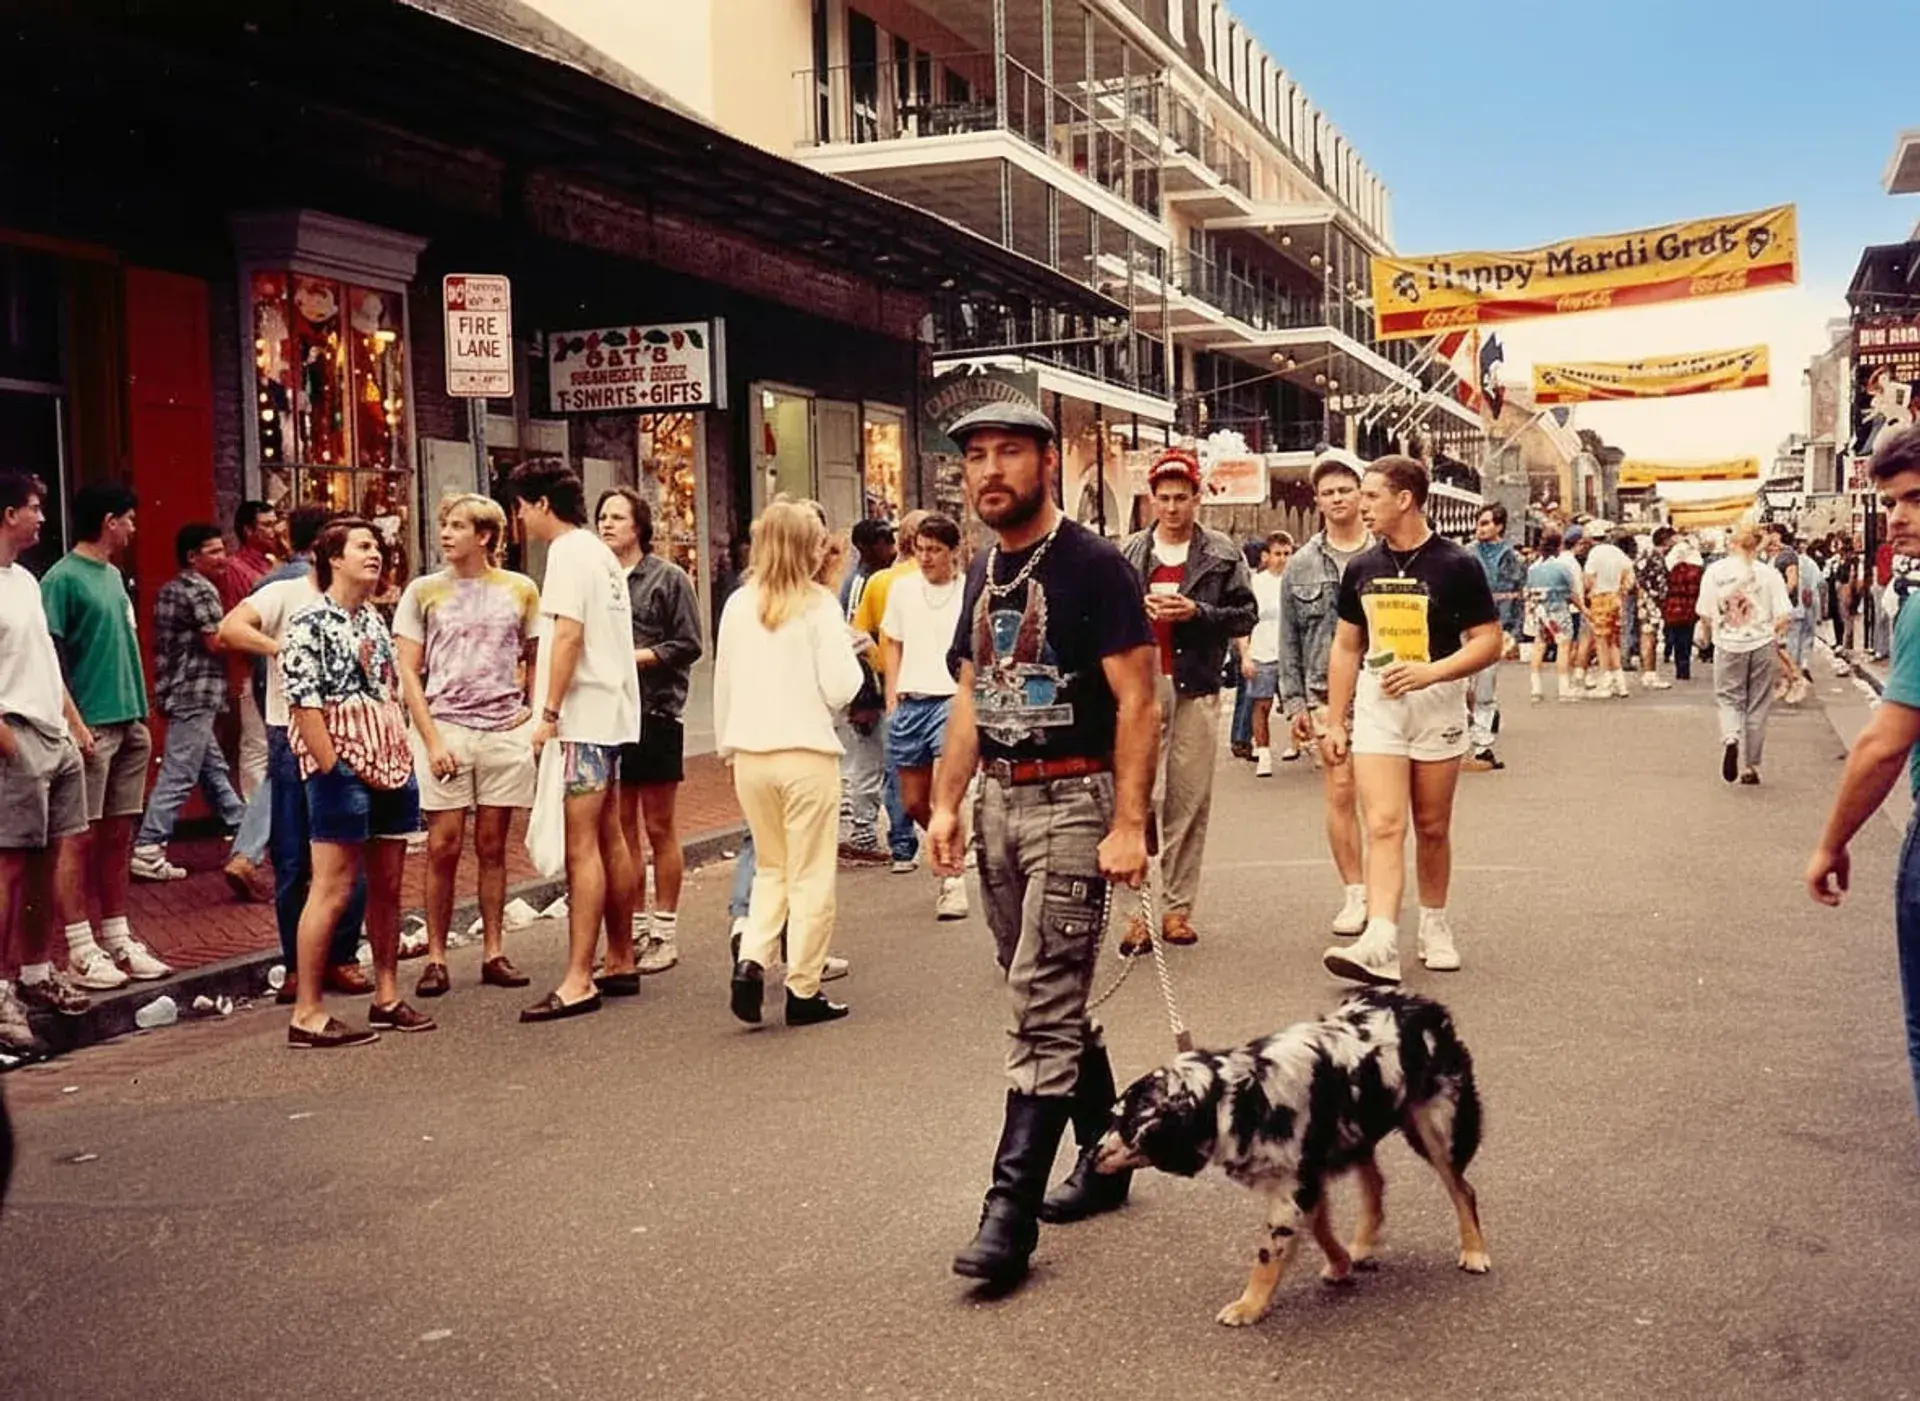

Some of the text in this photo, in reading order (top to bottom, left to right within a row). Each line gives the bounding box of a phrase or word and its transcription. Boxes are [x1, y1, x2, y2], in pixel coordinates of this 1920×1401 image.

[1427, 261, 1536, 294] Happy
[1546, 237, 1649, 277] Mardi
[459, 316, 499, 336] FIRE
[457, 339, 502, 358] LANE
[650, 382, 703, 404] GIFTS
